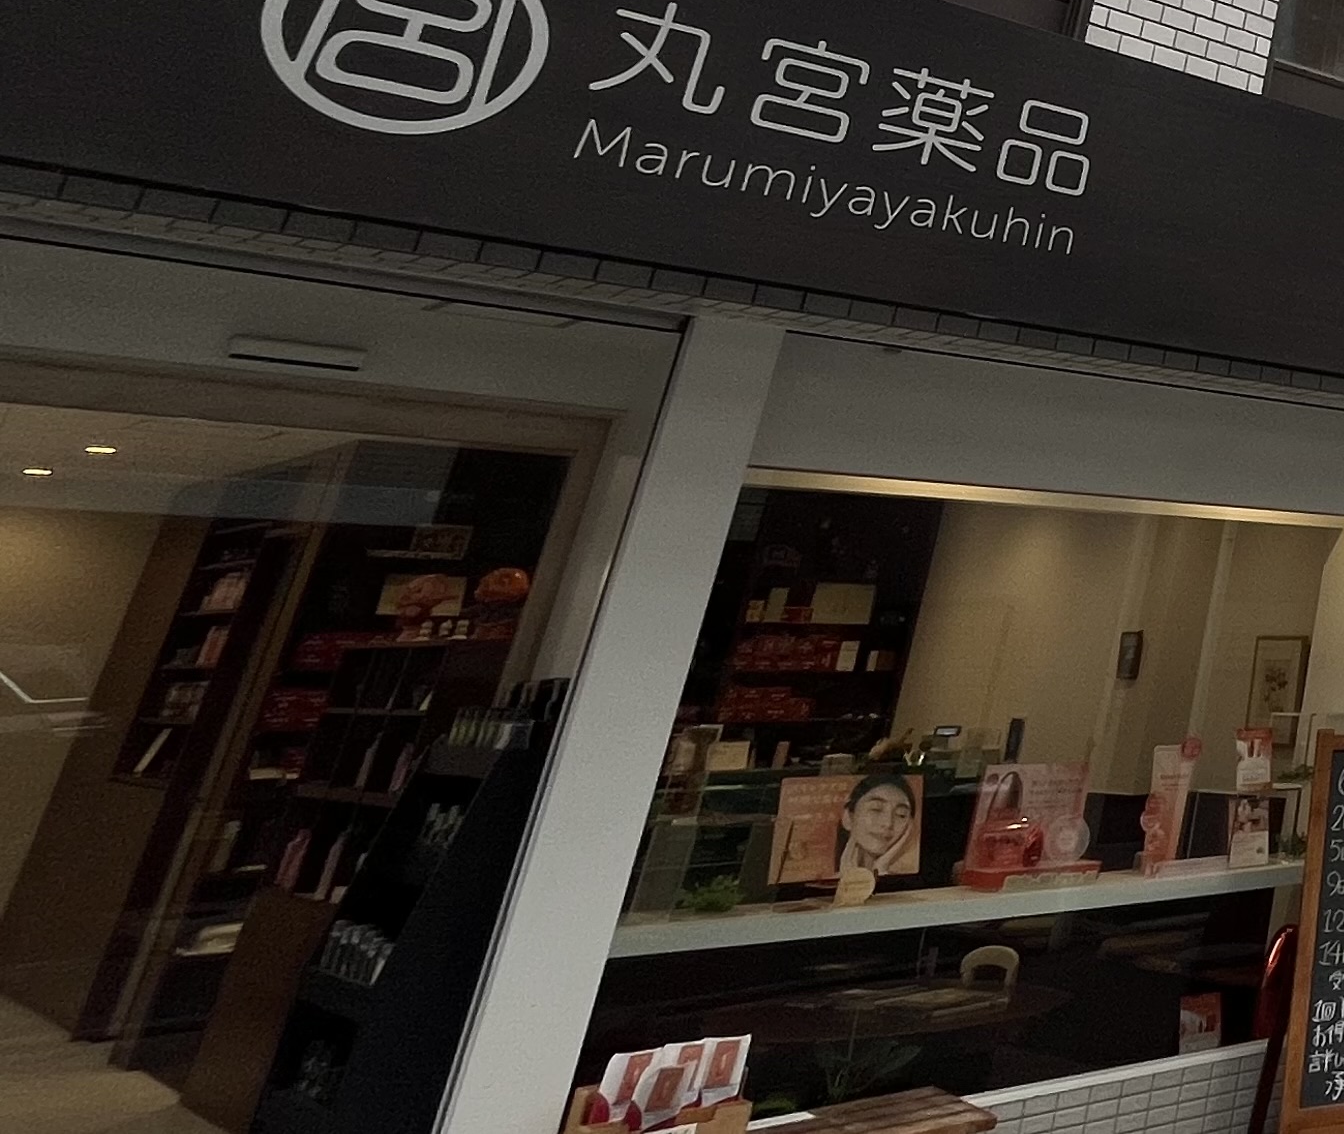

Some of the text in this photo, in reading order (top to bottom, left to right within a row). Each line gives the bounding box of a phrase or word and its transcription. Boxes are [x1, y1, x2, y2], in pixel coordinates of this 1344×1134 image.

[588, 1, 1092, 197] 丸宮薬品
[573, 117, 1075, 255] Marumiyayakuhin
